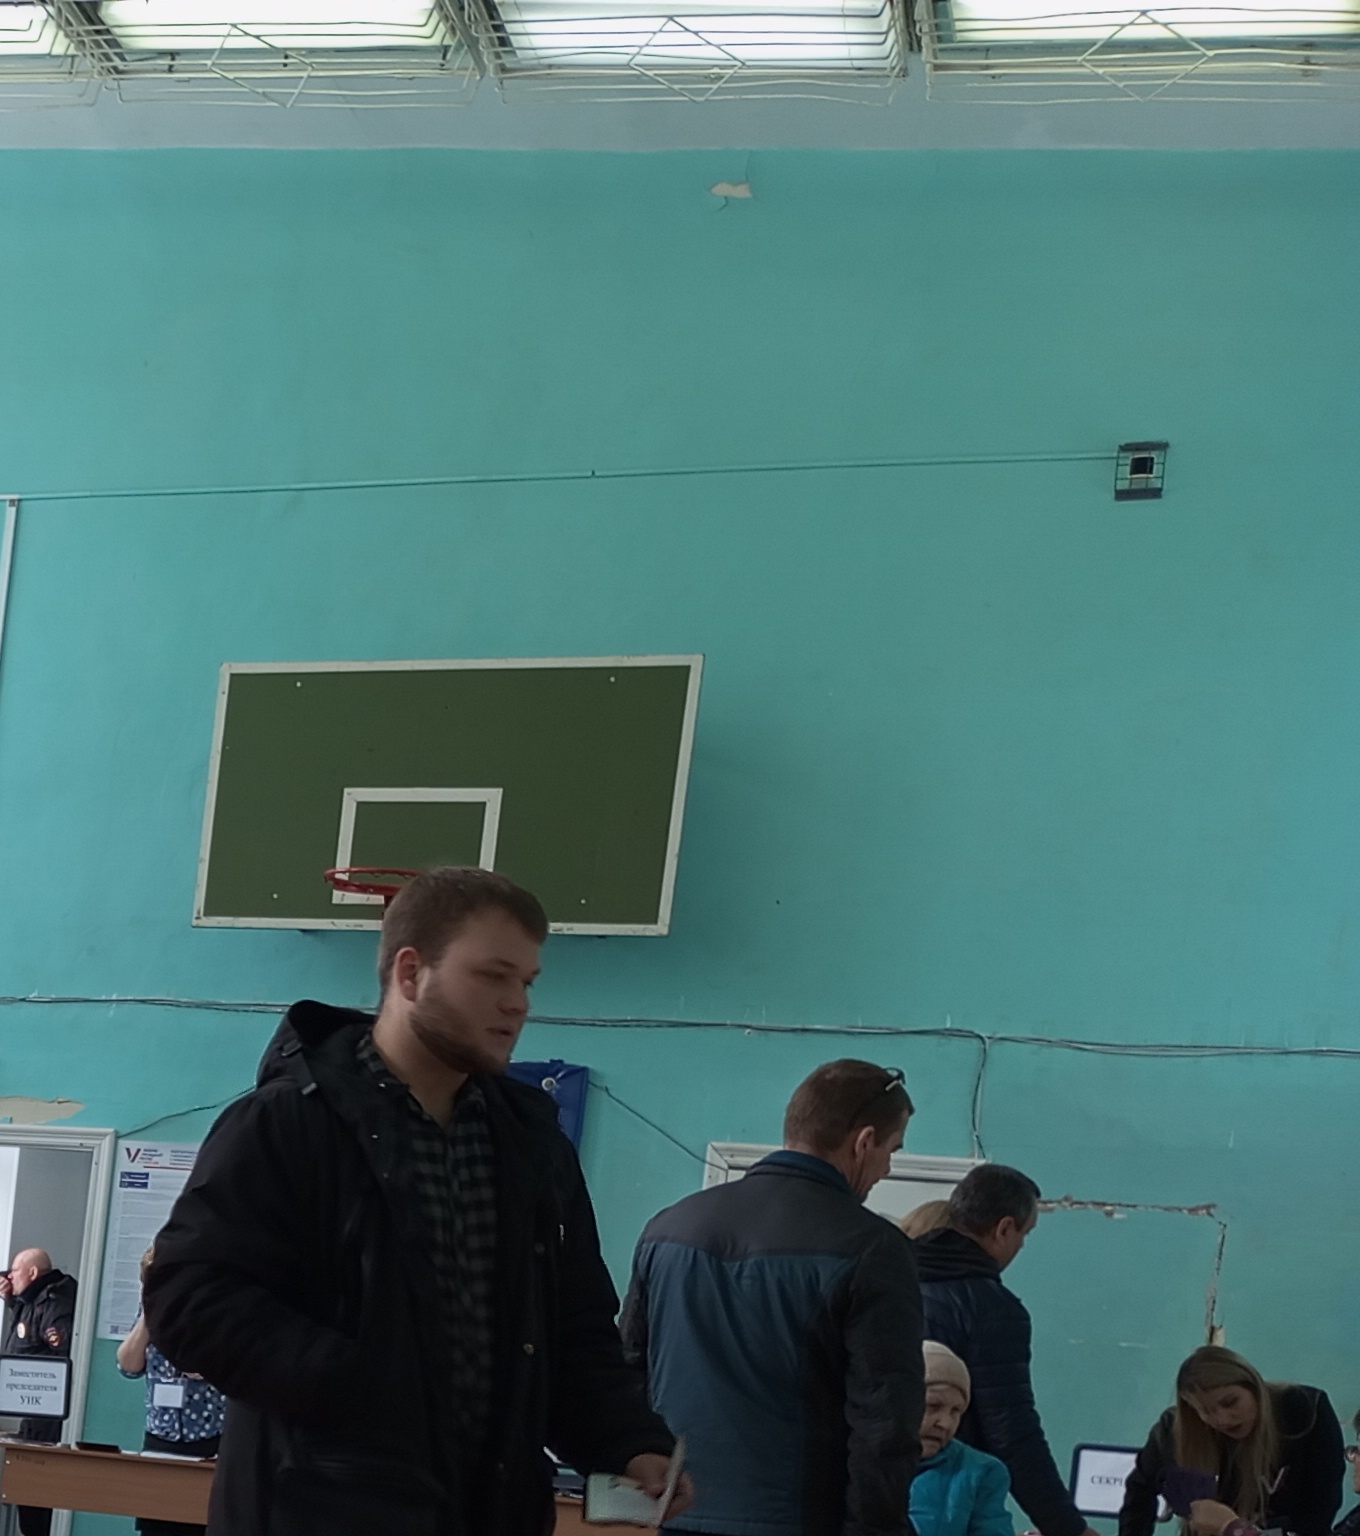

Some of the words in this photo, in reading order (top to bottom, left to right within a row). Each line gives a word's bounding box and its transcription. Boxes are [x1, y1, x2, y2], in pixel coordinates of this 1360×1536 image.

[9, 1368, 57, 1379] Заместитель
[6, 1382, 58, 1392] председателя
[20, 1395, 42, 1406] УИК
